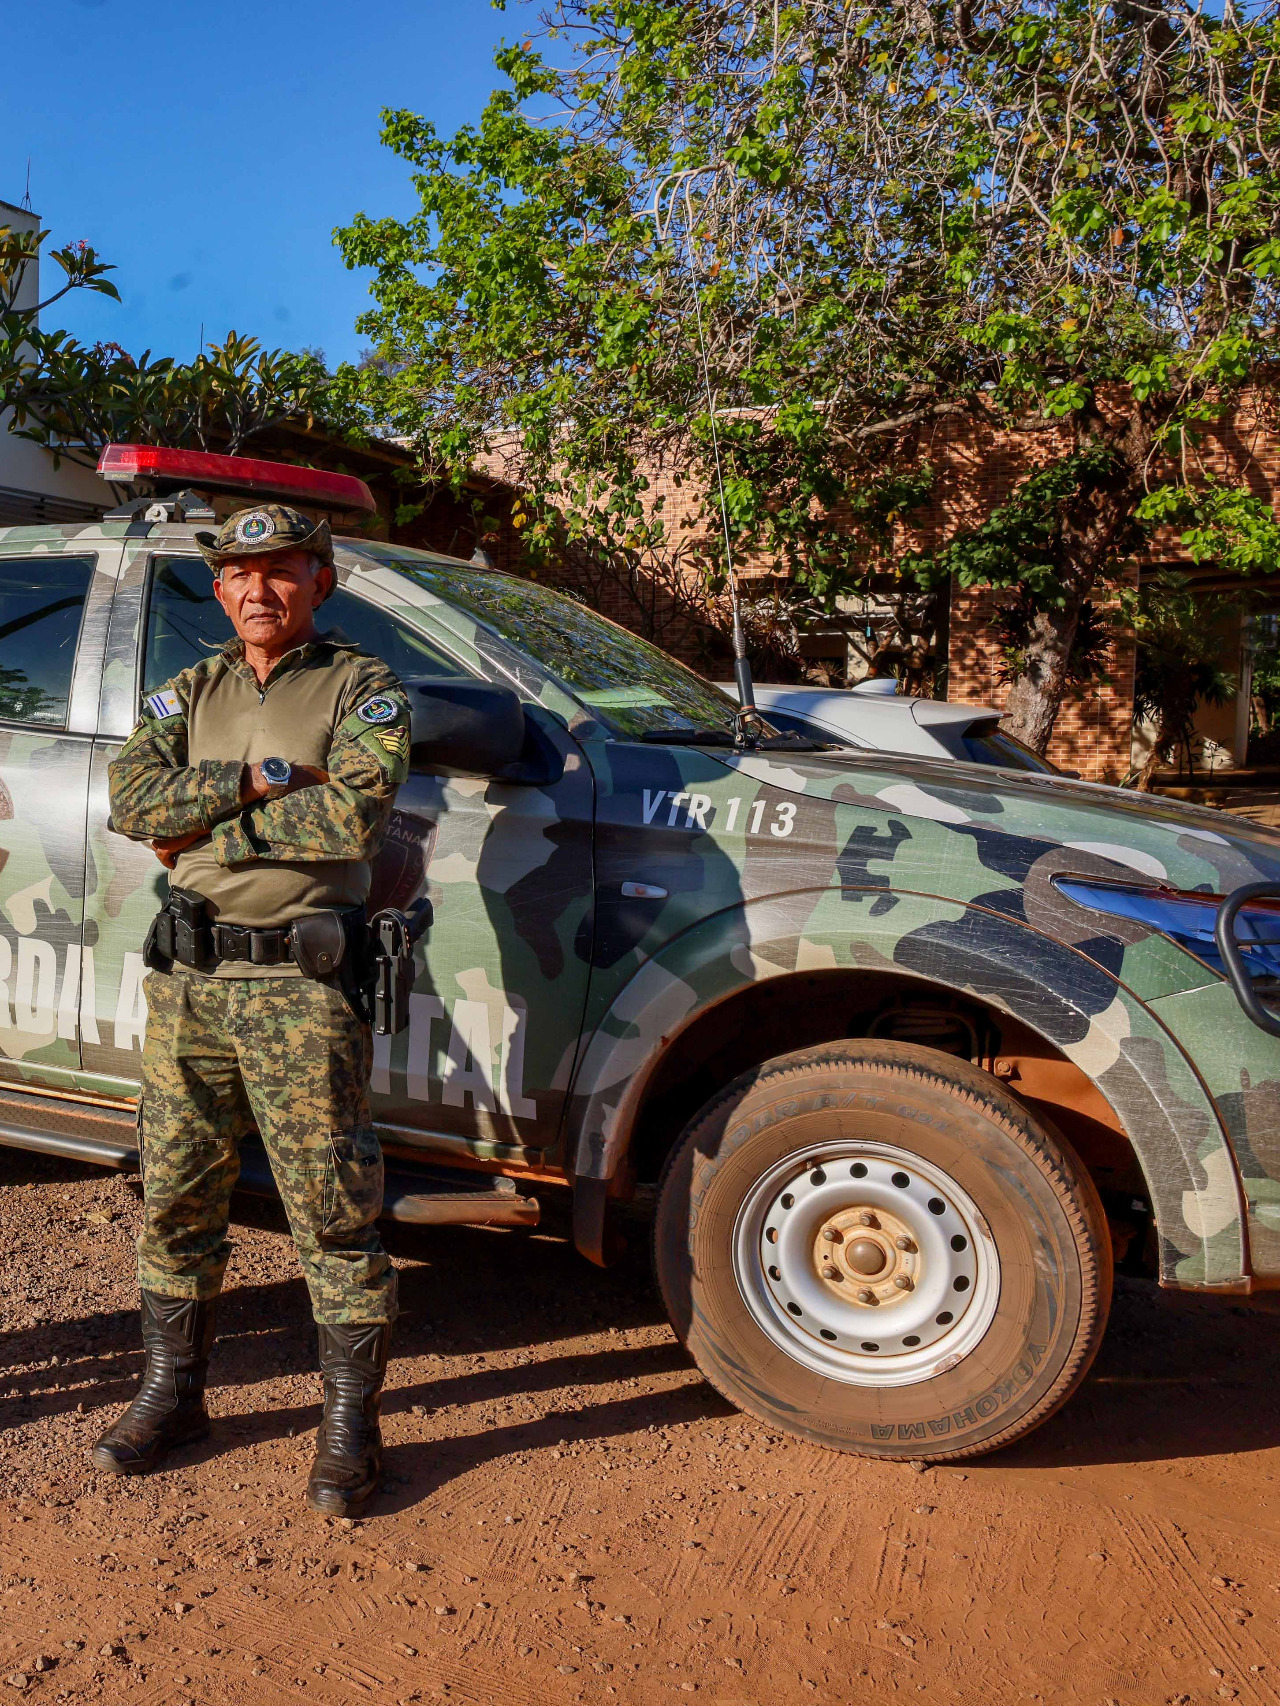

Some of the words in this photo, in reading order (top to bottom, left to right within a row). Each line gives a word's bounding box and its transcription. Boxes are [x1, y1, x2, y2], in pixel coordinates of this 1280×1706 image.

[642, 788, 712, 830] VTR
[725, 796, 798, 838] 113
[870, 1341, 1048, 1441] YOKOHAMA
